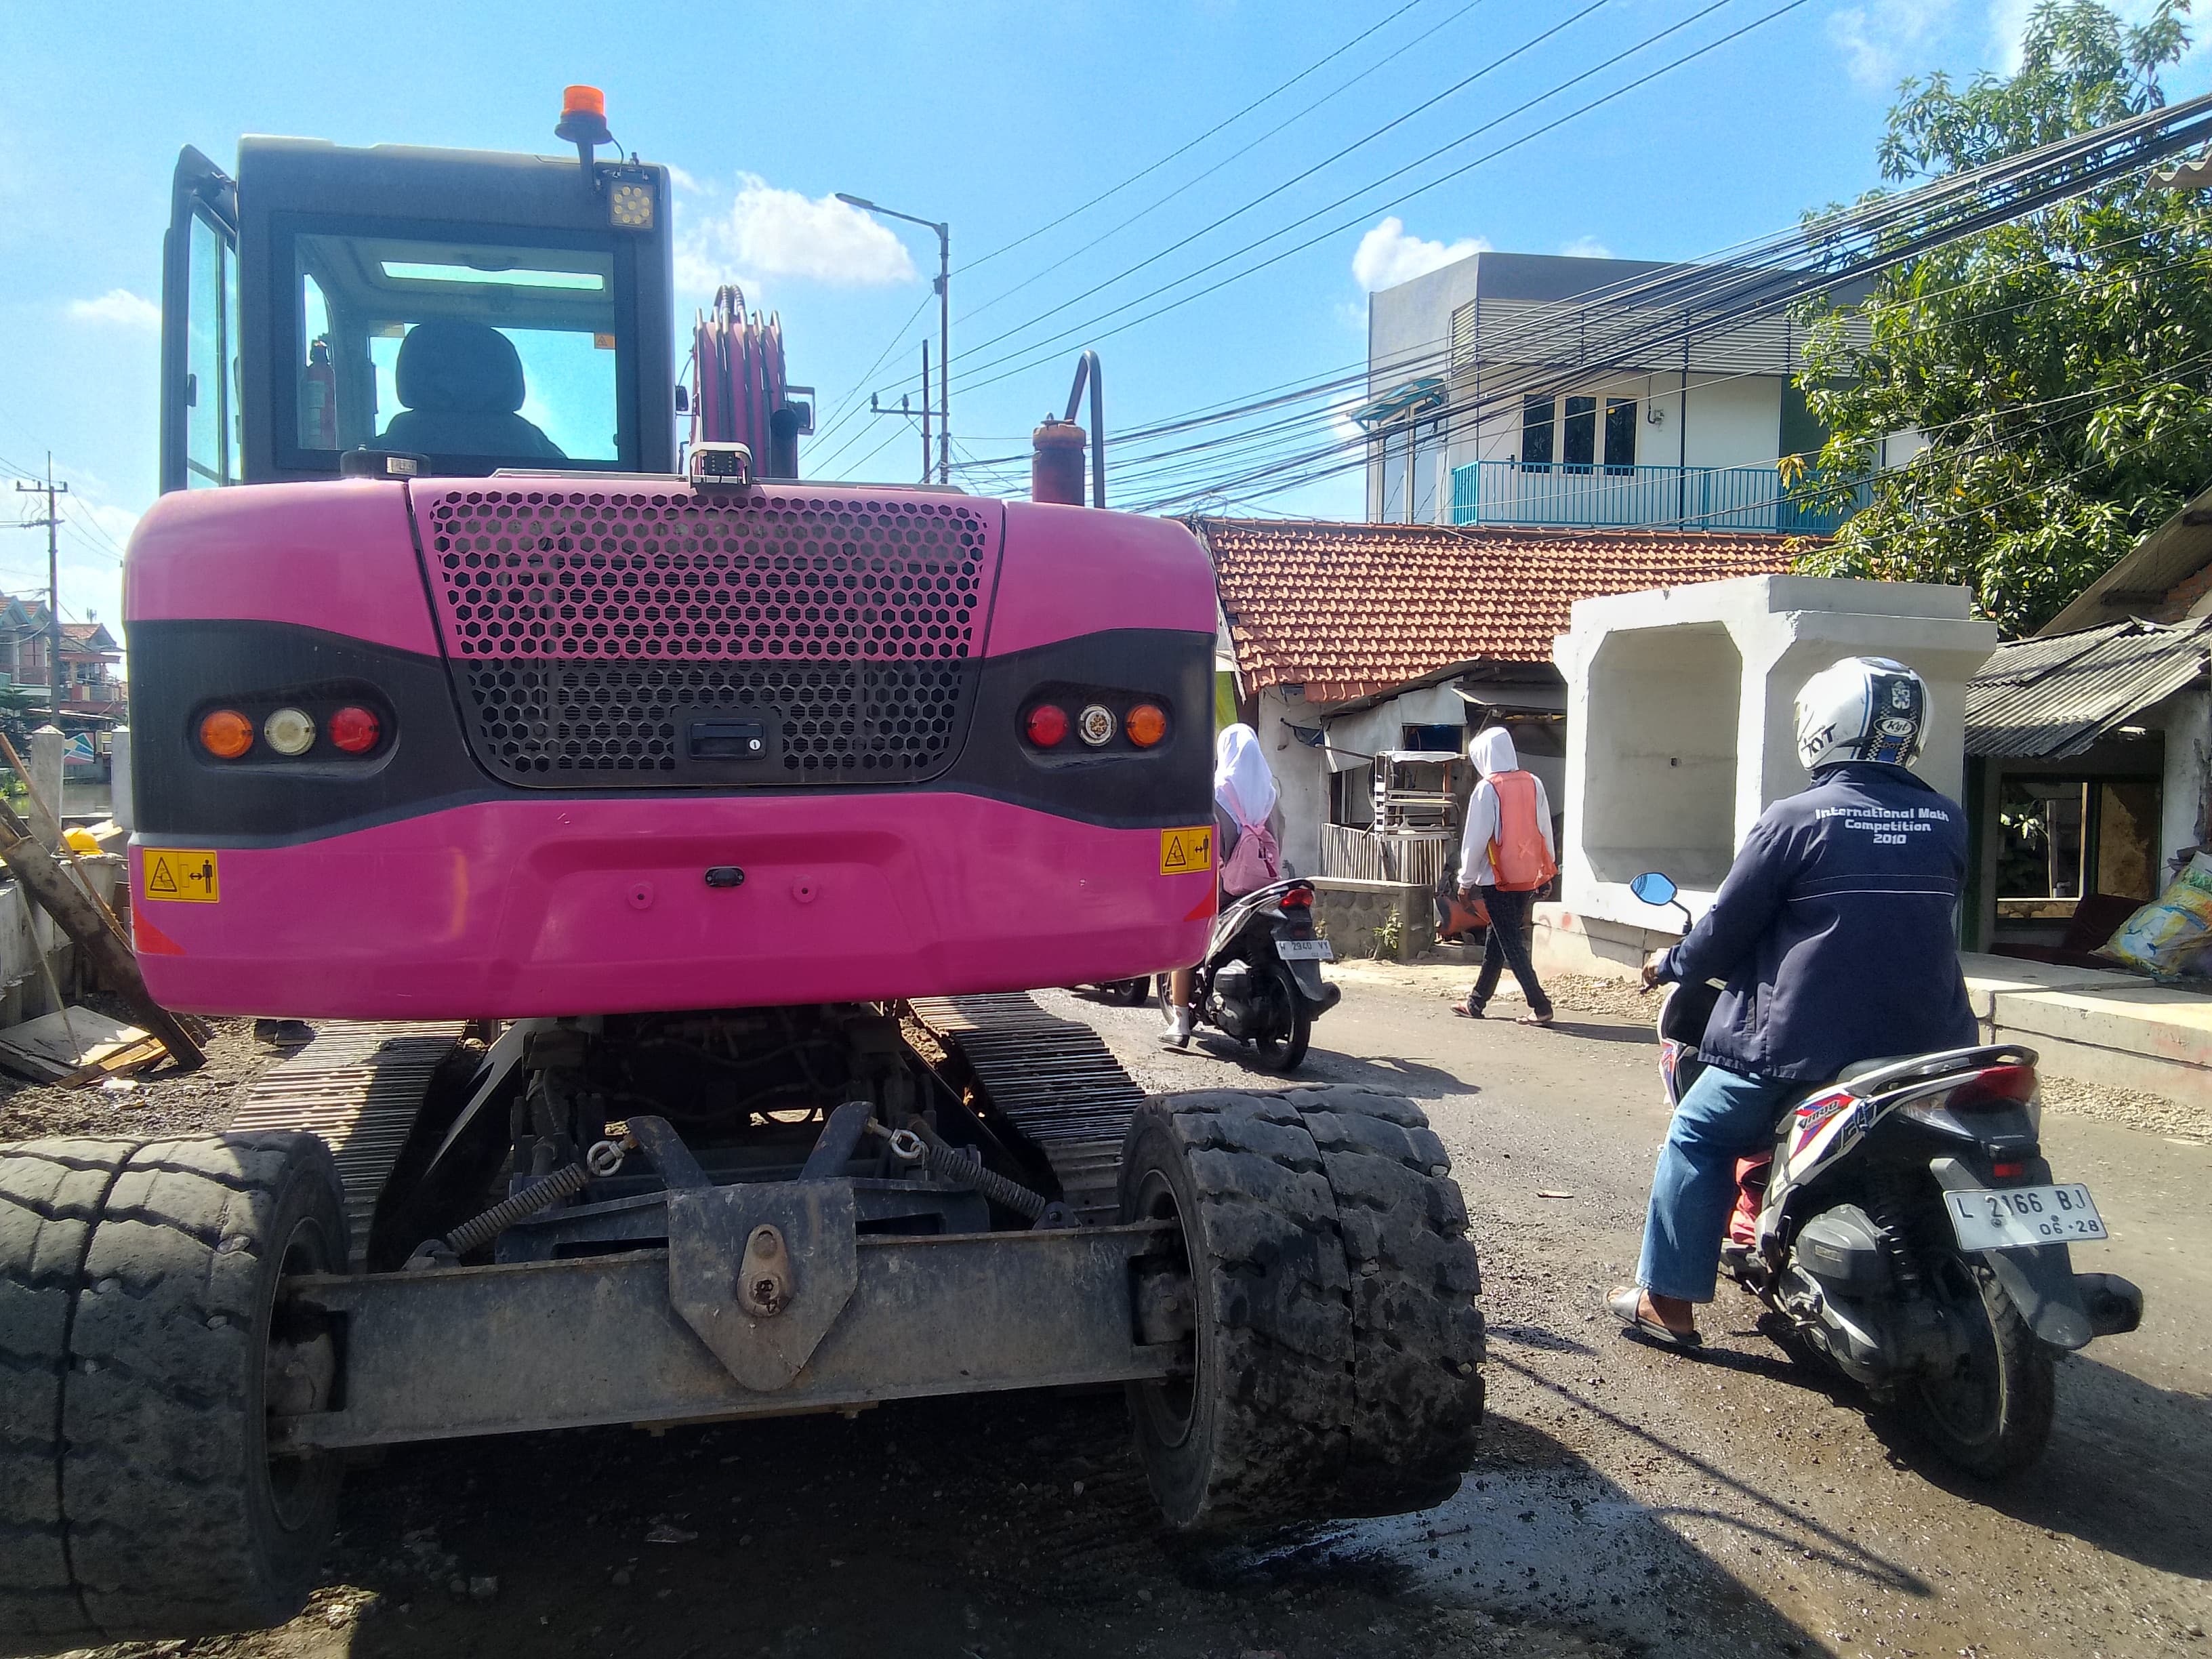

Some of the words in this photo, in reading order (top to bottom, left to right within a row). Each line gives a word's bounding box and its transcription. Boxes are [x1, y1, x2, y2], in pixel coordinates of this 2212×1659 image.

[1887, 720, 1909, 735] Kyt
[1815, 807, 1914, 819] International
[1918, 808, 1950, 822] Math
[1845, 819, 1931, 833] Competition
[1873, 834, 1907, 844] 2010
[1291, 942, 1312, 950] 2940
[1957, 1197, 1973, 1218] L
[1985, 1192, 2043, 1218] 2166
[2055, 1189, 2086, 1210] BJ
